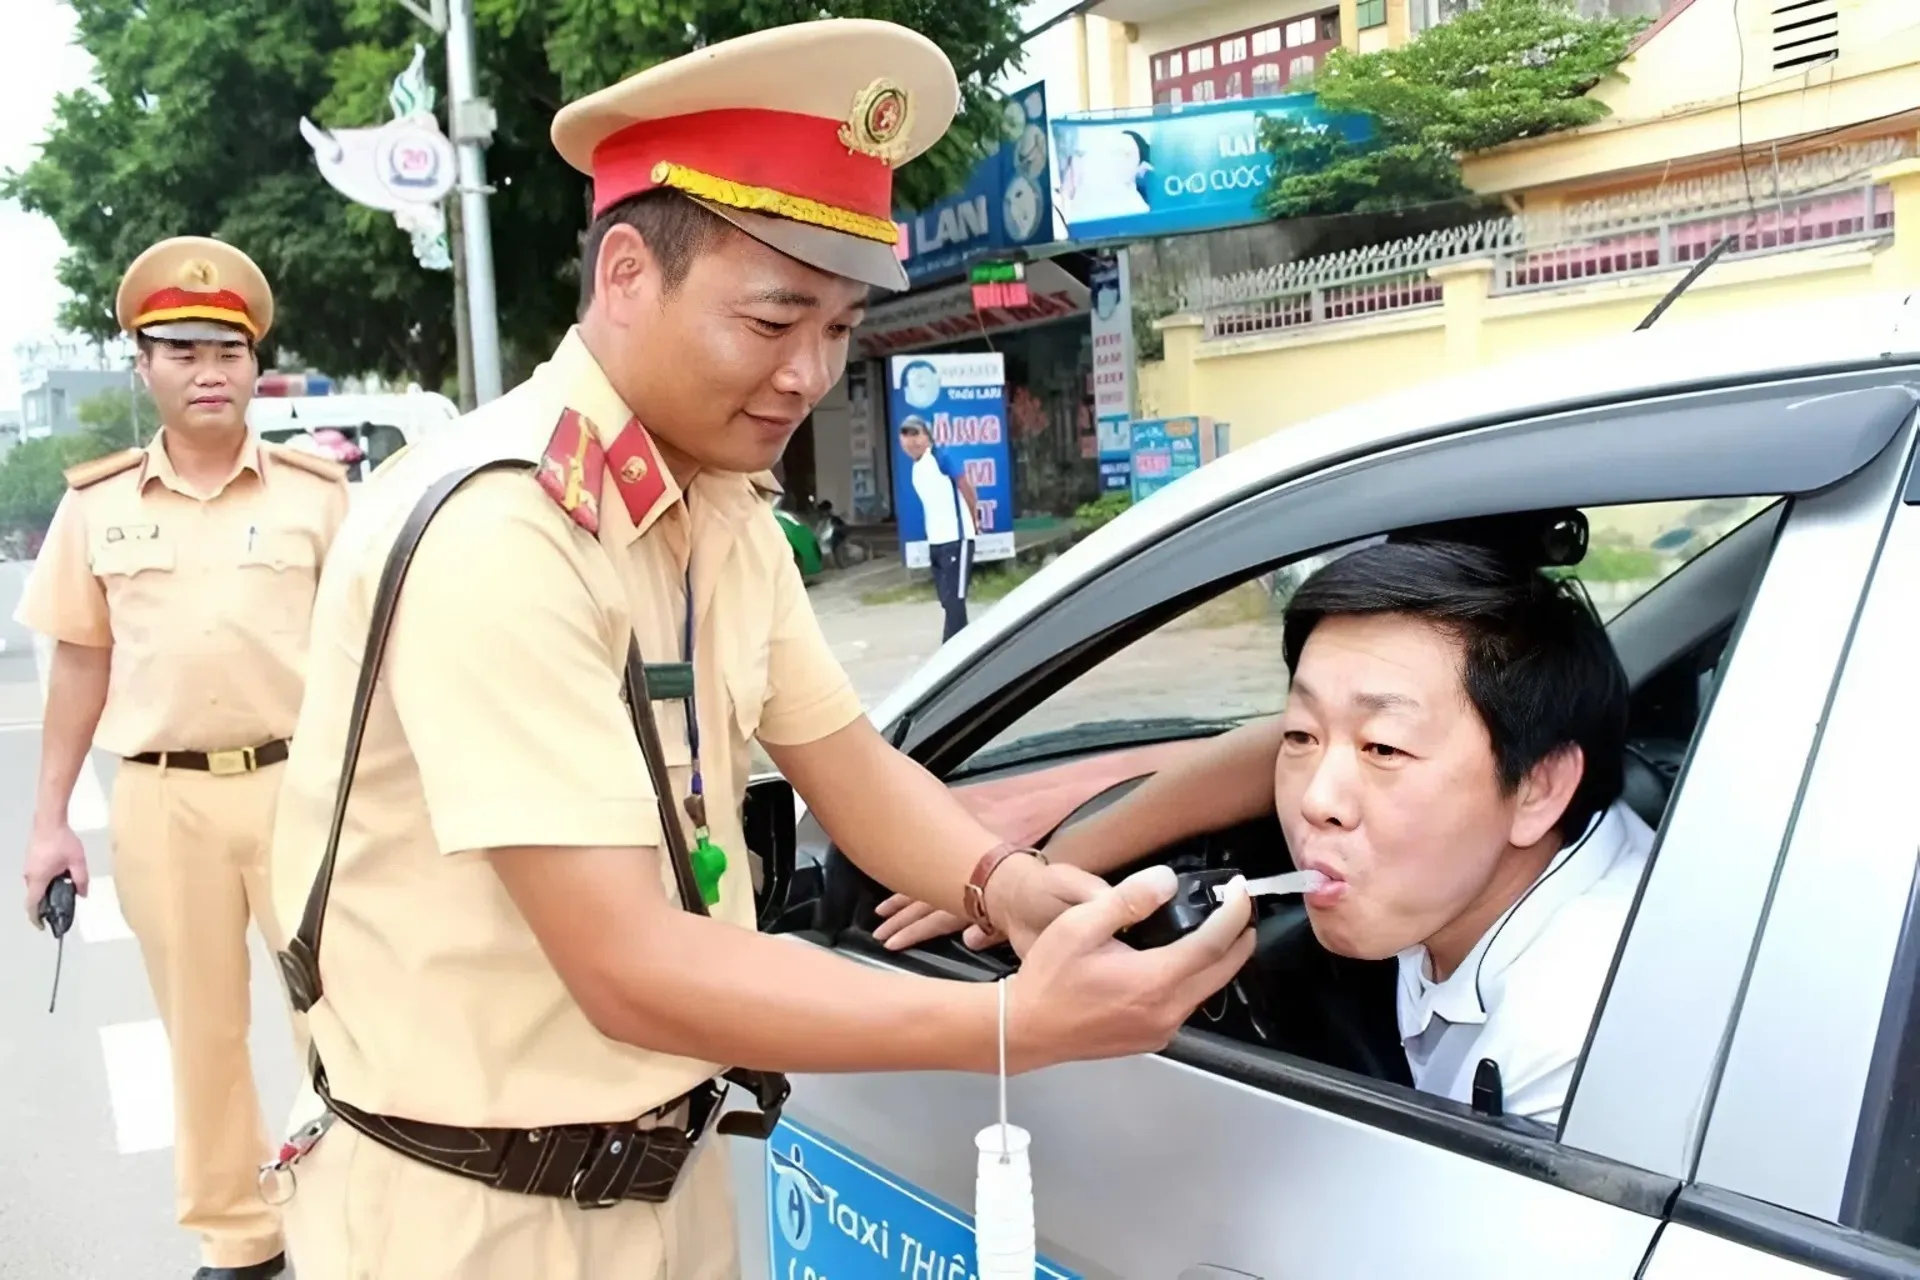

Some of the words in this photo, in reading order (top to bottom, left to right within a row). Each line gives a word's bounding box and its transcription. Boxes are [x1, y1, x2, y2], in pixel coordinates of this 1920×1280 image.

[915, 195, 989, 255] LAN
[823, 1185, 889, 1259] Taxi
[901, 1233, 978, 1280] THIÊ
